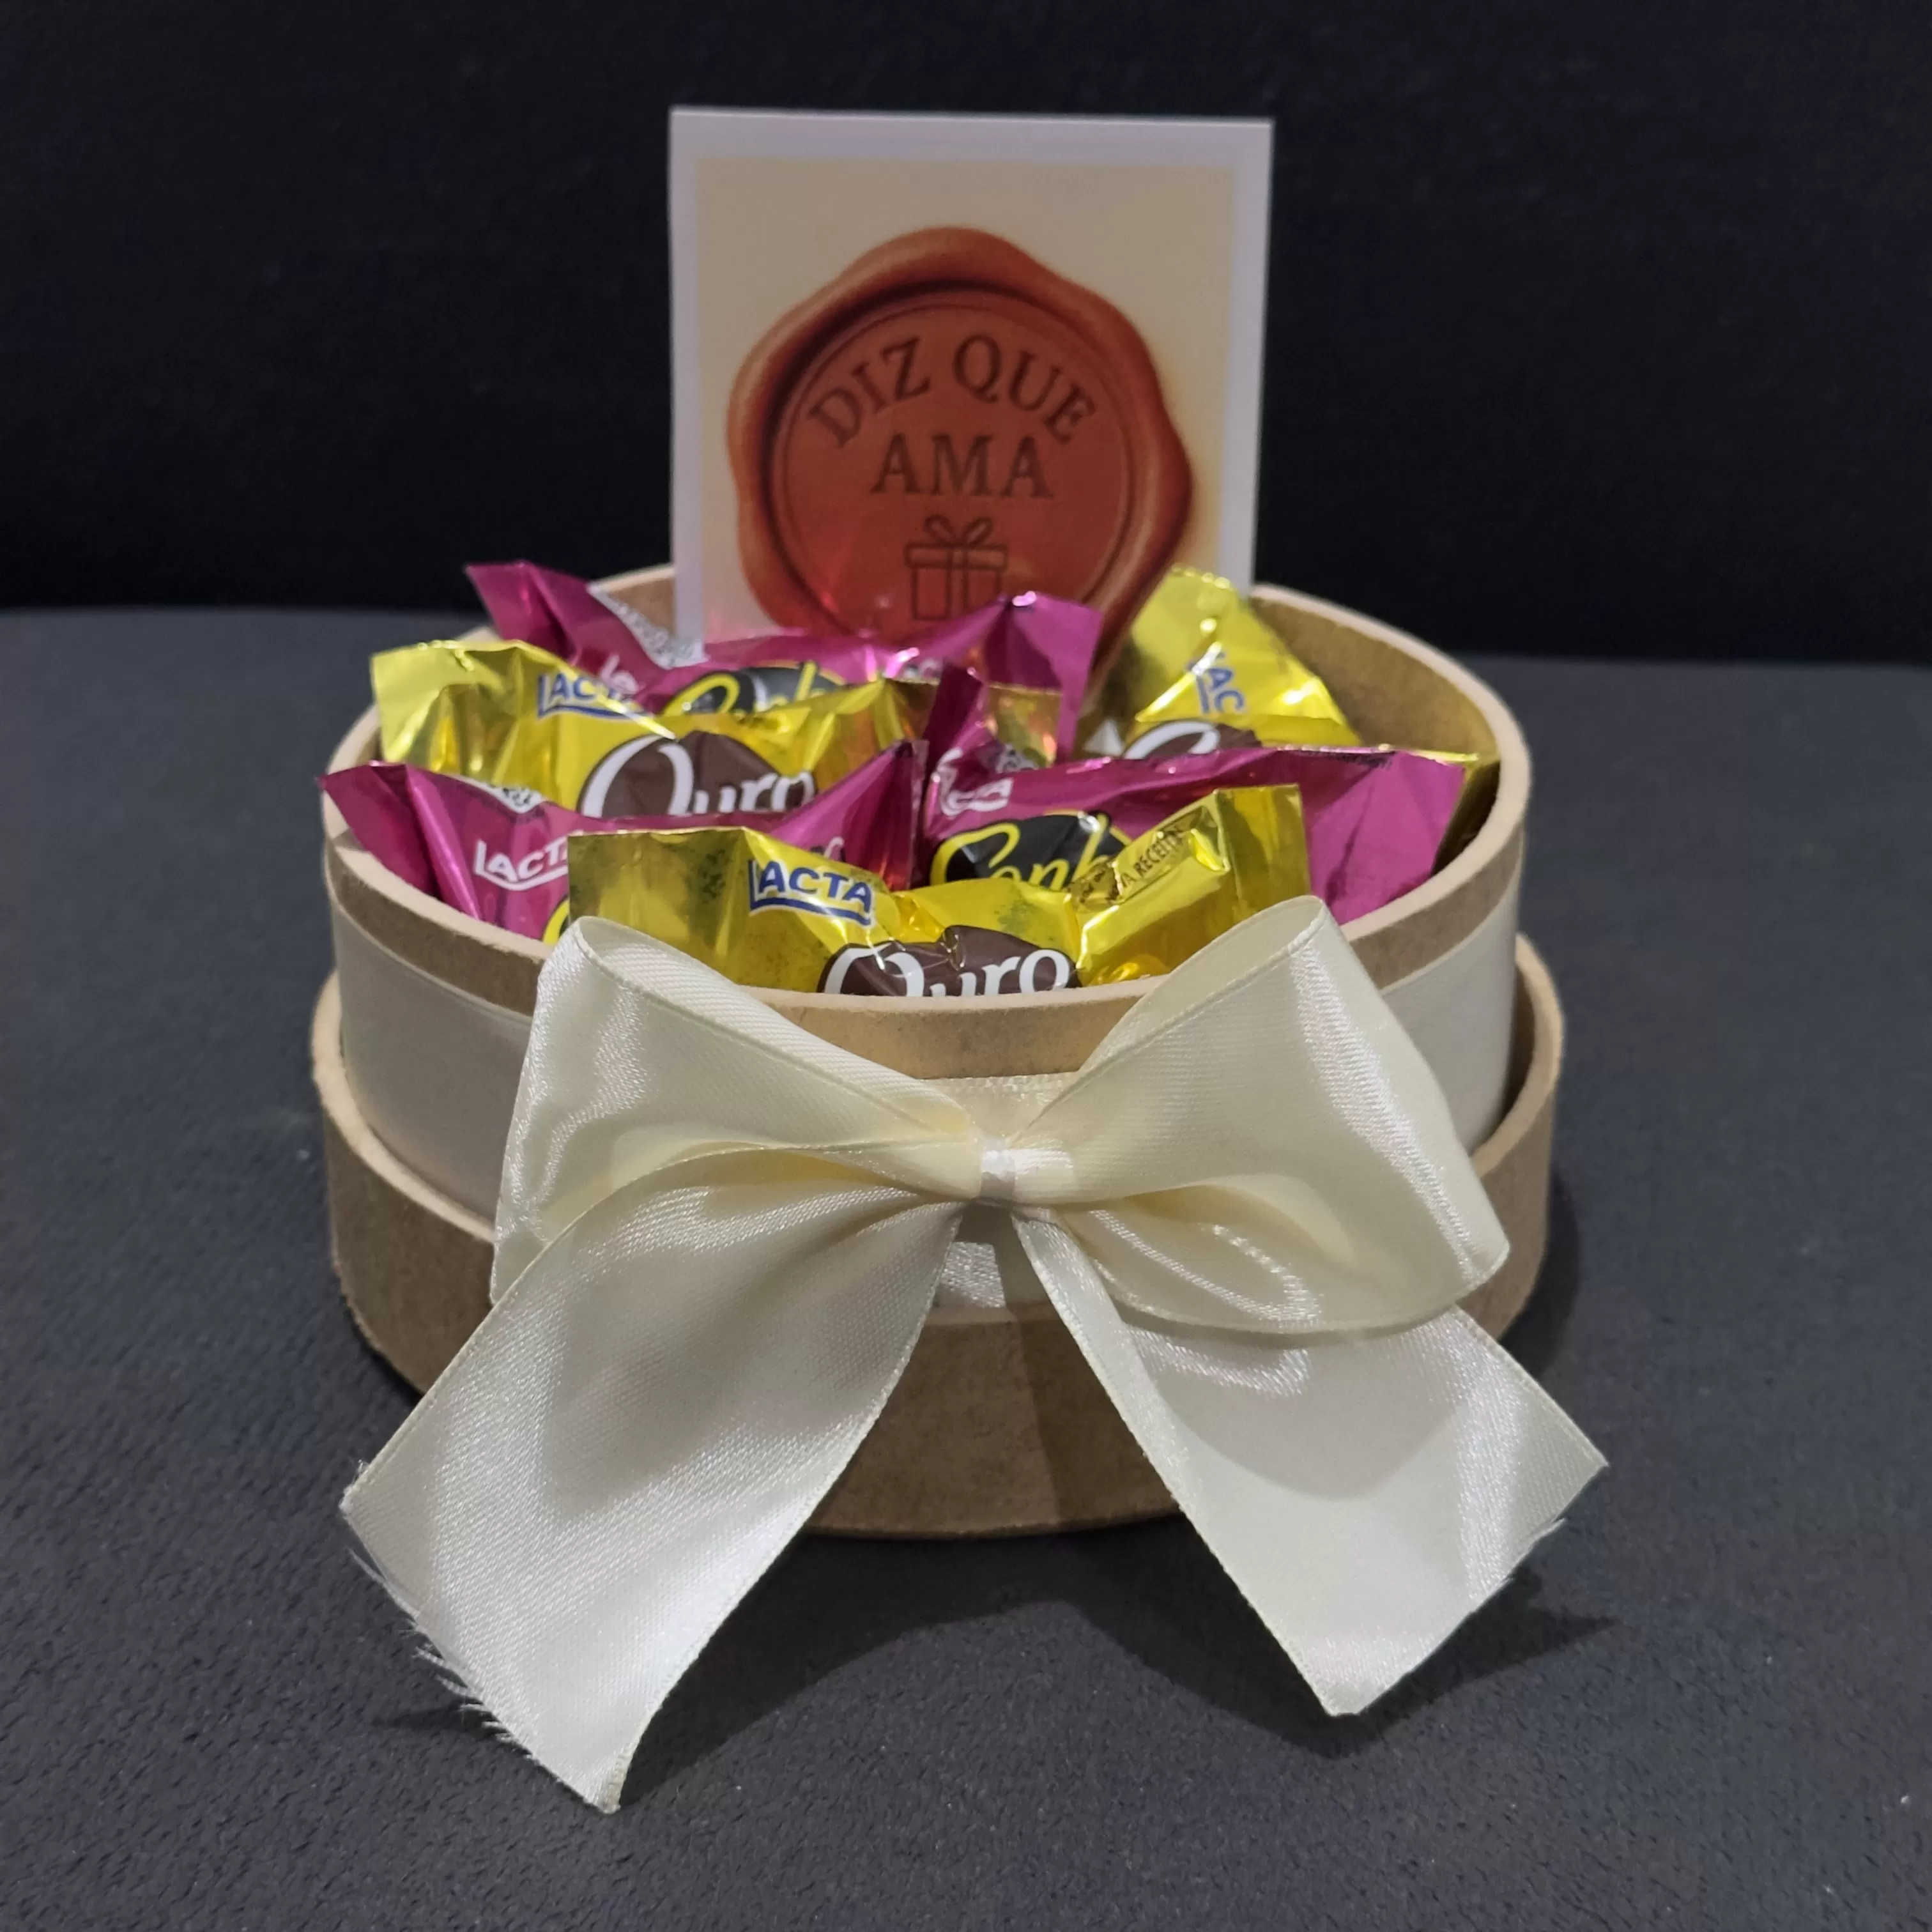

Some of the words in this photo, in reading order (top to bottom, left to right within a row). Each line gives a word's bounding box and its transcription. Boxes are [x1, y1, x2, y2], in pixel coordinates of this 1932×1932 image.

[807, 336, 931, 448] DIZ
[951, 334, 1098, 445] QUE
[869, 433, 1055, 500] AMA
[473, 838, 568, 891] LACT
[748, 857, 875, 927] LACTA
